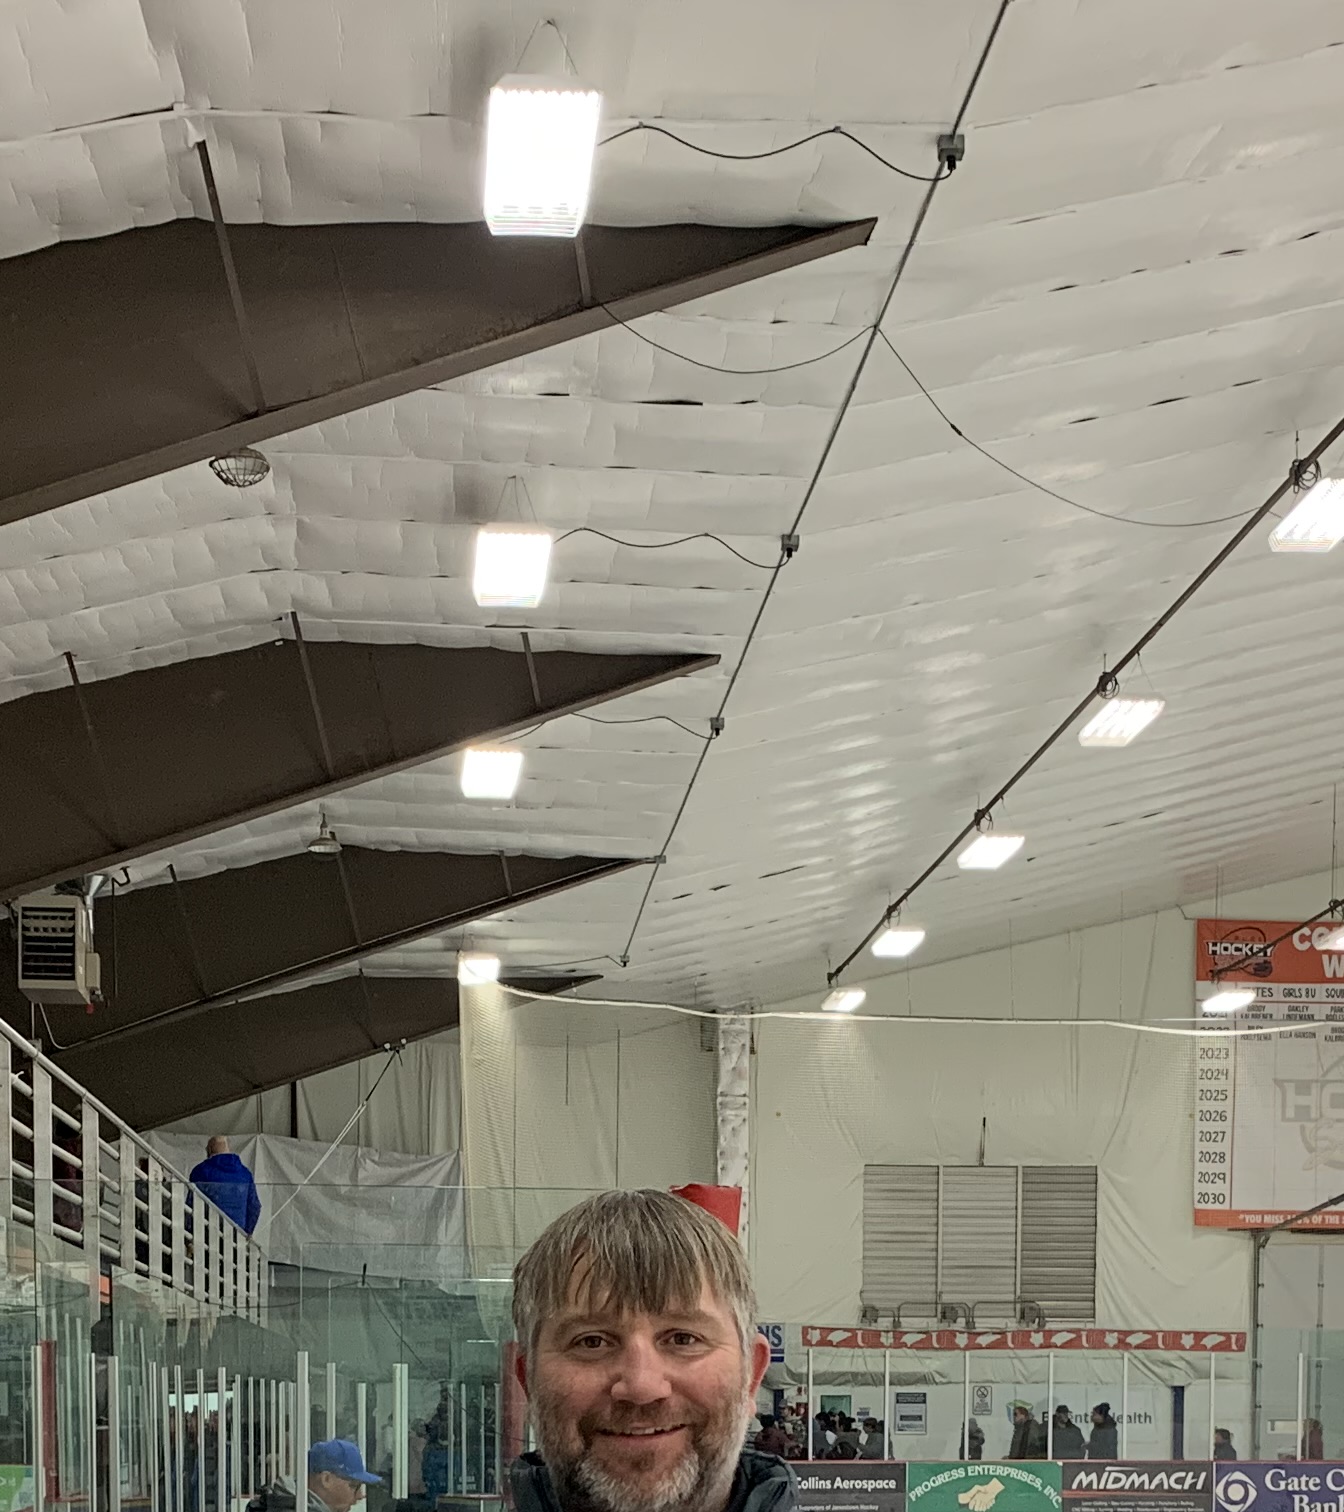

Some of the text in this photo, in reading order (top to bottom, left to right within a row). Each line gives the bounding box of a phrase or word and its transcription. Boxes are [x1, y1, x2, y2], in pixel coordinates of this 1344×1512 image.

[1282, 988, 1302, 998] GIRLS
[1199, 1047, 1229, 1060] 2023
[1198, 1068, 1229, 1081] 2024
[1198, 1089, 1228, 1101] 2025
[1198, 1110, 1228, 1122] 2026
[1198, 1131, 1226, 1143] 2027
[1198, 1151, 1226, 1163] 2028
[1197, 1172, 1226, 1184] 2029
[1197, 1192, 1226, 1204] 2030
[1312, 1215, 1323, 1225] OF
[1325, 1215, 1340, 1225] THE
[796, 1476, 897, 1492] Collins Aerospace
[909, 1466, 966, 1502] PROGRESS
[967, 1465, 1043, 1491] ENTERPRISES,
[1071, 1466, 1207, 1490] MIDMACH
[1264, 1468, 1321, 1491] Gate
